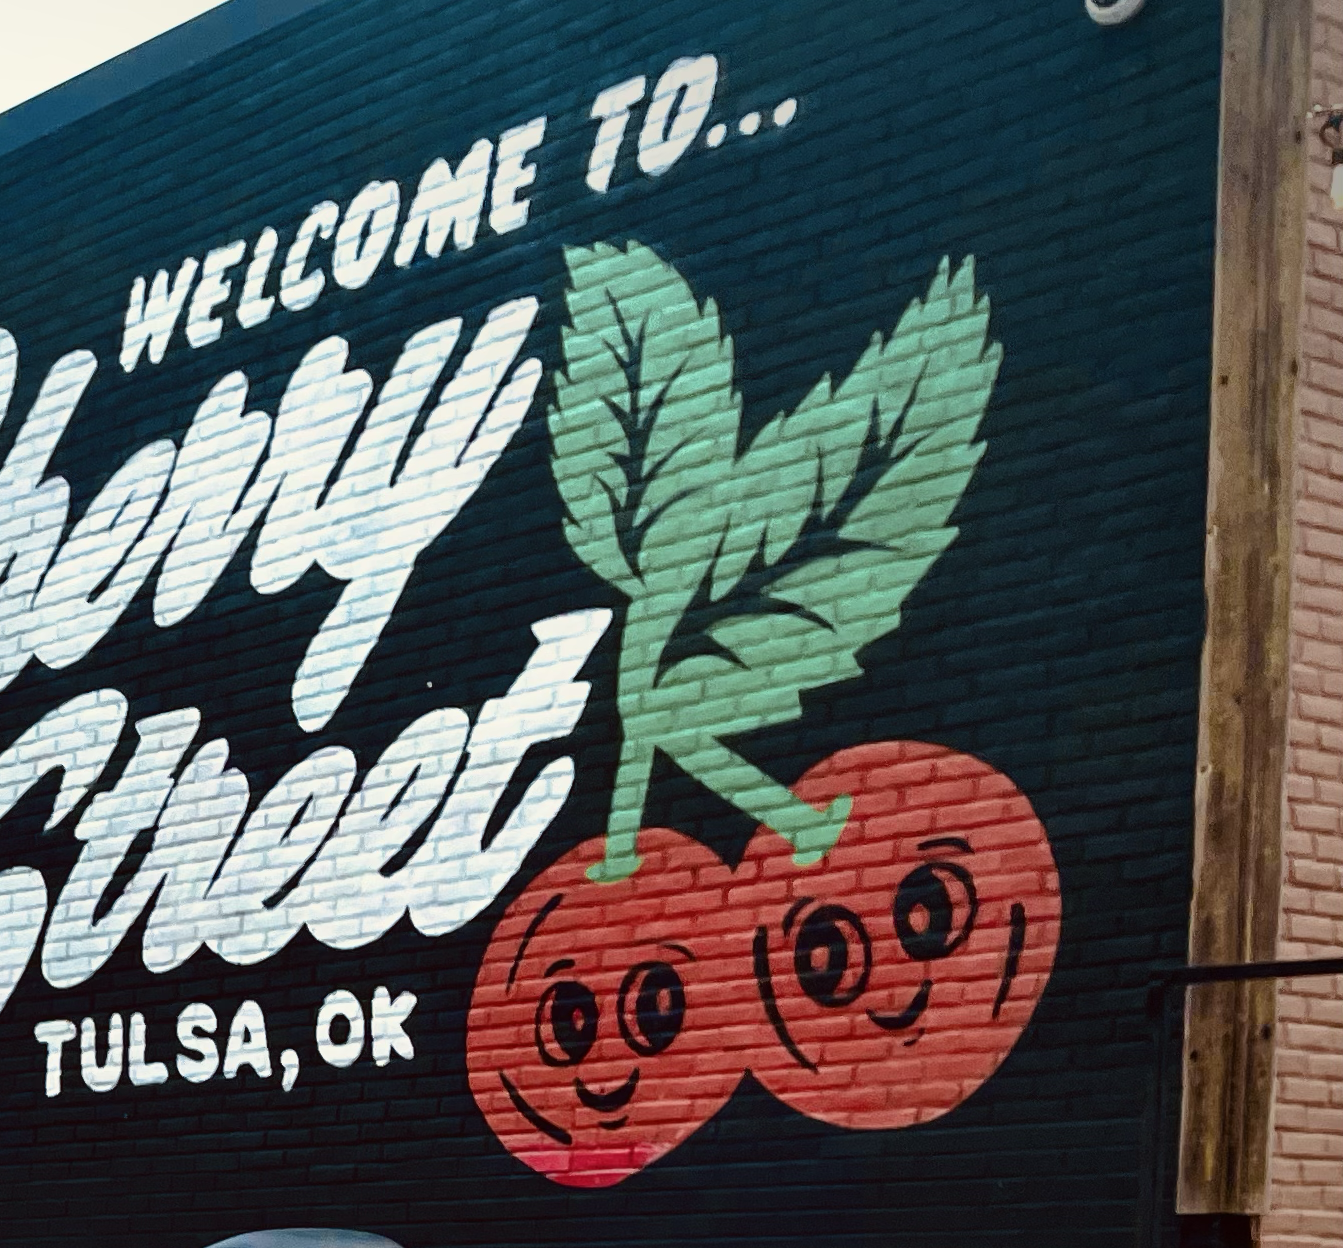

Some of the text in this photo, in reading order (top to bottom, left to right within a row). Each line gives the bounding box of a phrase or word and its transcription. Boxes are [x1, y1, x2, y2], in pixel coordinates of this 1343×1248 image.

[119, 54, 797, 372] WELCOME TO...
[33, 985, 418, 1098] TULSA, OK
